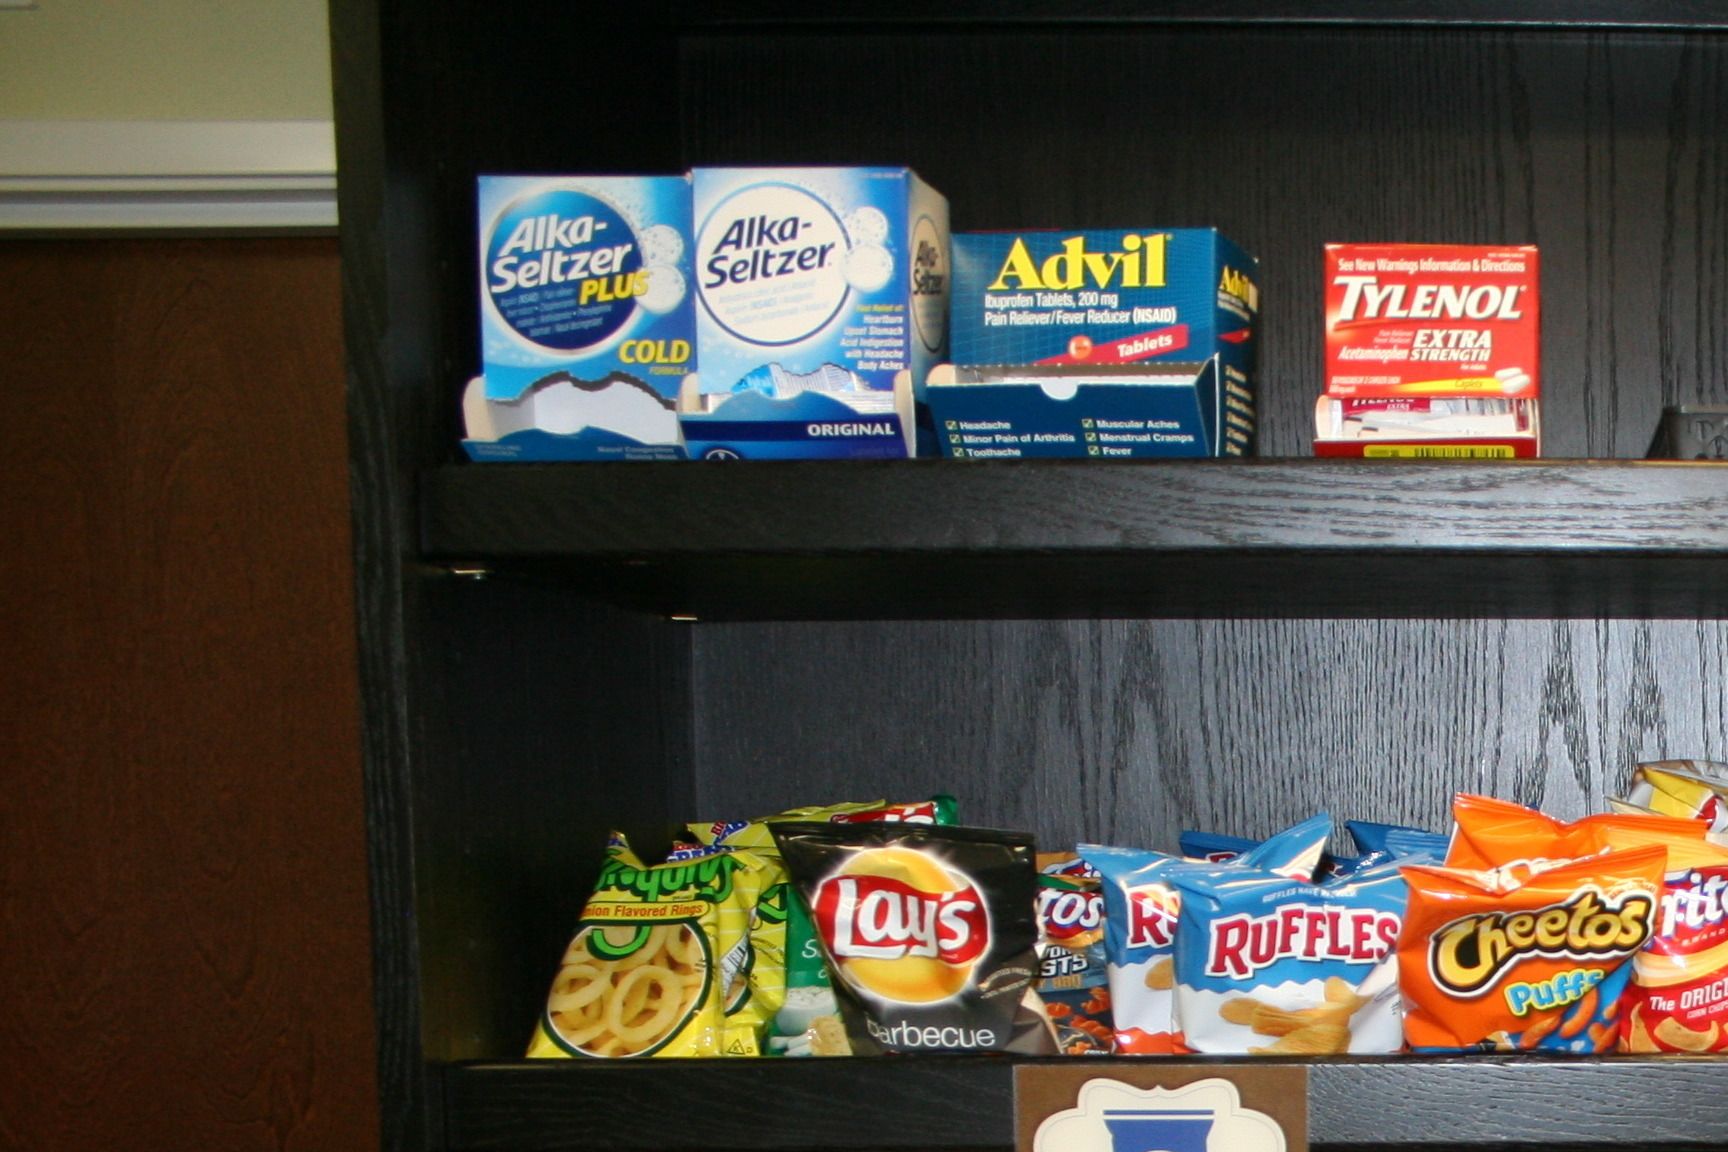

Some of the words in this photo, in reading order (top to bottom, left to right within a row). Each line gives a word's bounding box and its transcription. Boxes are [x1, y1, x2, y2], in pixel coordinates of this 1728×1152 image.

[498, 214, 607, 256] Alka-
[714, 214, 811, 255] Alka-
[490, 244, 633, 294] Seltzer
[704, 243, 833, 289] Seltzer
[987, 233, 1166, 290] Advil
[1338, 258, 1354, 271] See
[1356, 259, 1374, 271] New
[1377, 259, 1419, 275] Warnings
[1419, 258, 1471, 272] Information
[1473, 258, 1479, 272] &
[1481, 259, 1525, 272] Directions
[579, 270, 649, 305] PLUS
[985, 293, 1033, 311] Ibuprofen
[1035, 293, 1076, 309] Tablets,
[1078, 292, 1098, 306] 200
[1101, 293, 1118, 309] mg
[1334, 276, 1523, 320] TYLENOL
[985, 312, 1007, 326] Pain
[1087, 309, 1131, 323] Reducer
[1132, 307, 1176, 324] (NSAID)
[619, 339, 690, 364] COLD
[1118, 334, 1173, 357] Tablets
[1413, 329, 1492, 348] EXTRA
[1409, 349, 1491, 361] STRENGTH
[807, 421, 895, 438] ORIGINAL
[615, 905, 666, 917] Flavored
[671, 904, 703, 918] Rings
[834, 879, 976, 959] Lay's
[1210, 909, 1399, 975] RUFFLES
[1434, 893, 1649, 990] Cheetos
[1650, 996, 1675, 1011] The
[1686, 1008, 1707, 1020] CORN
[866, 1015, 996, 1048] barbecue
